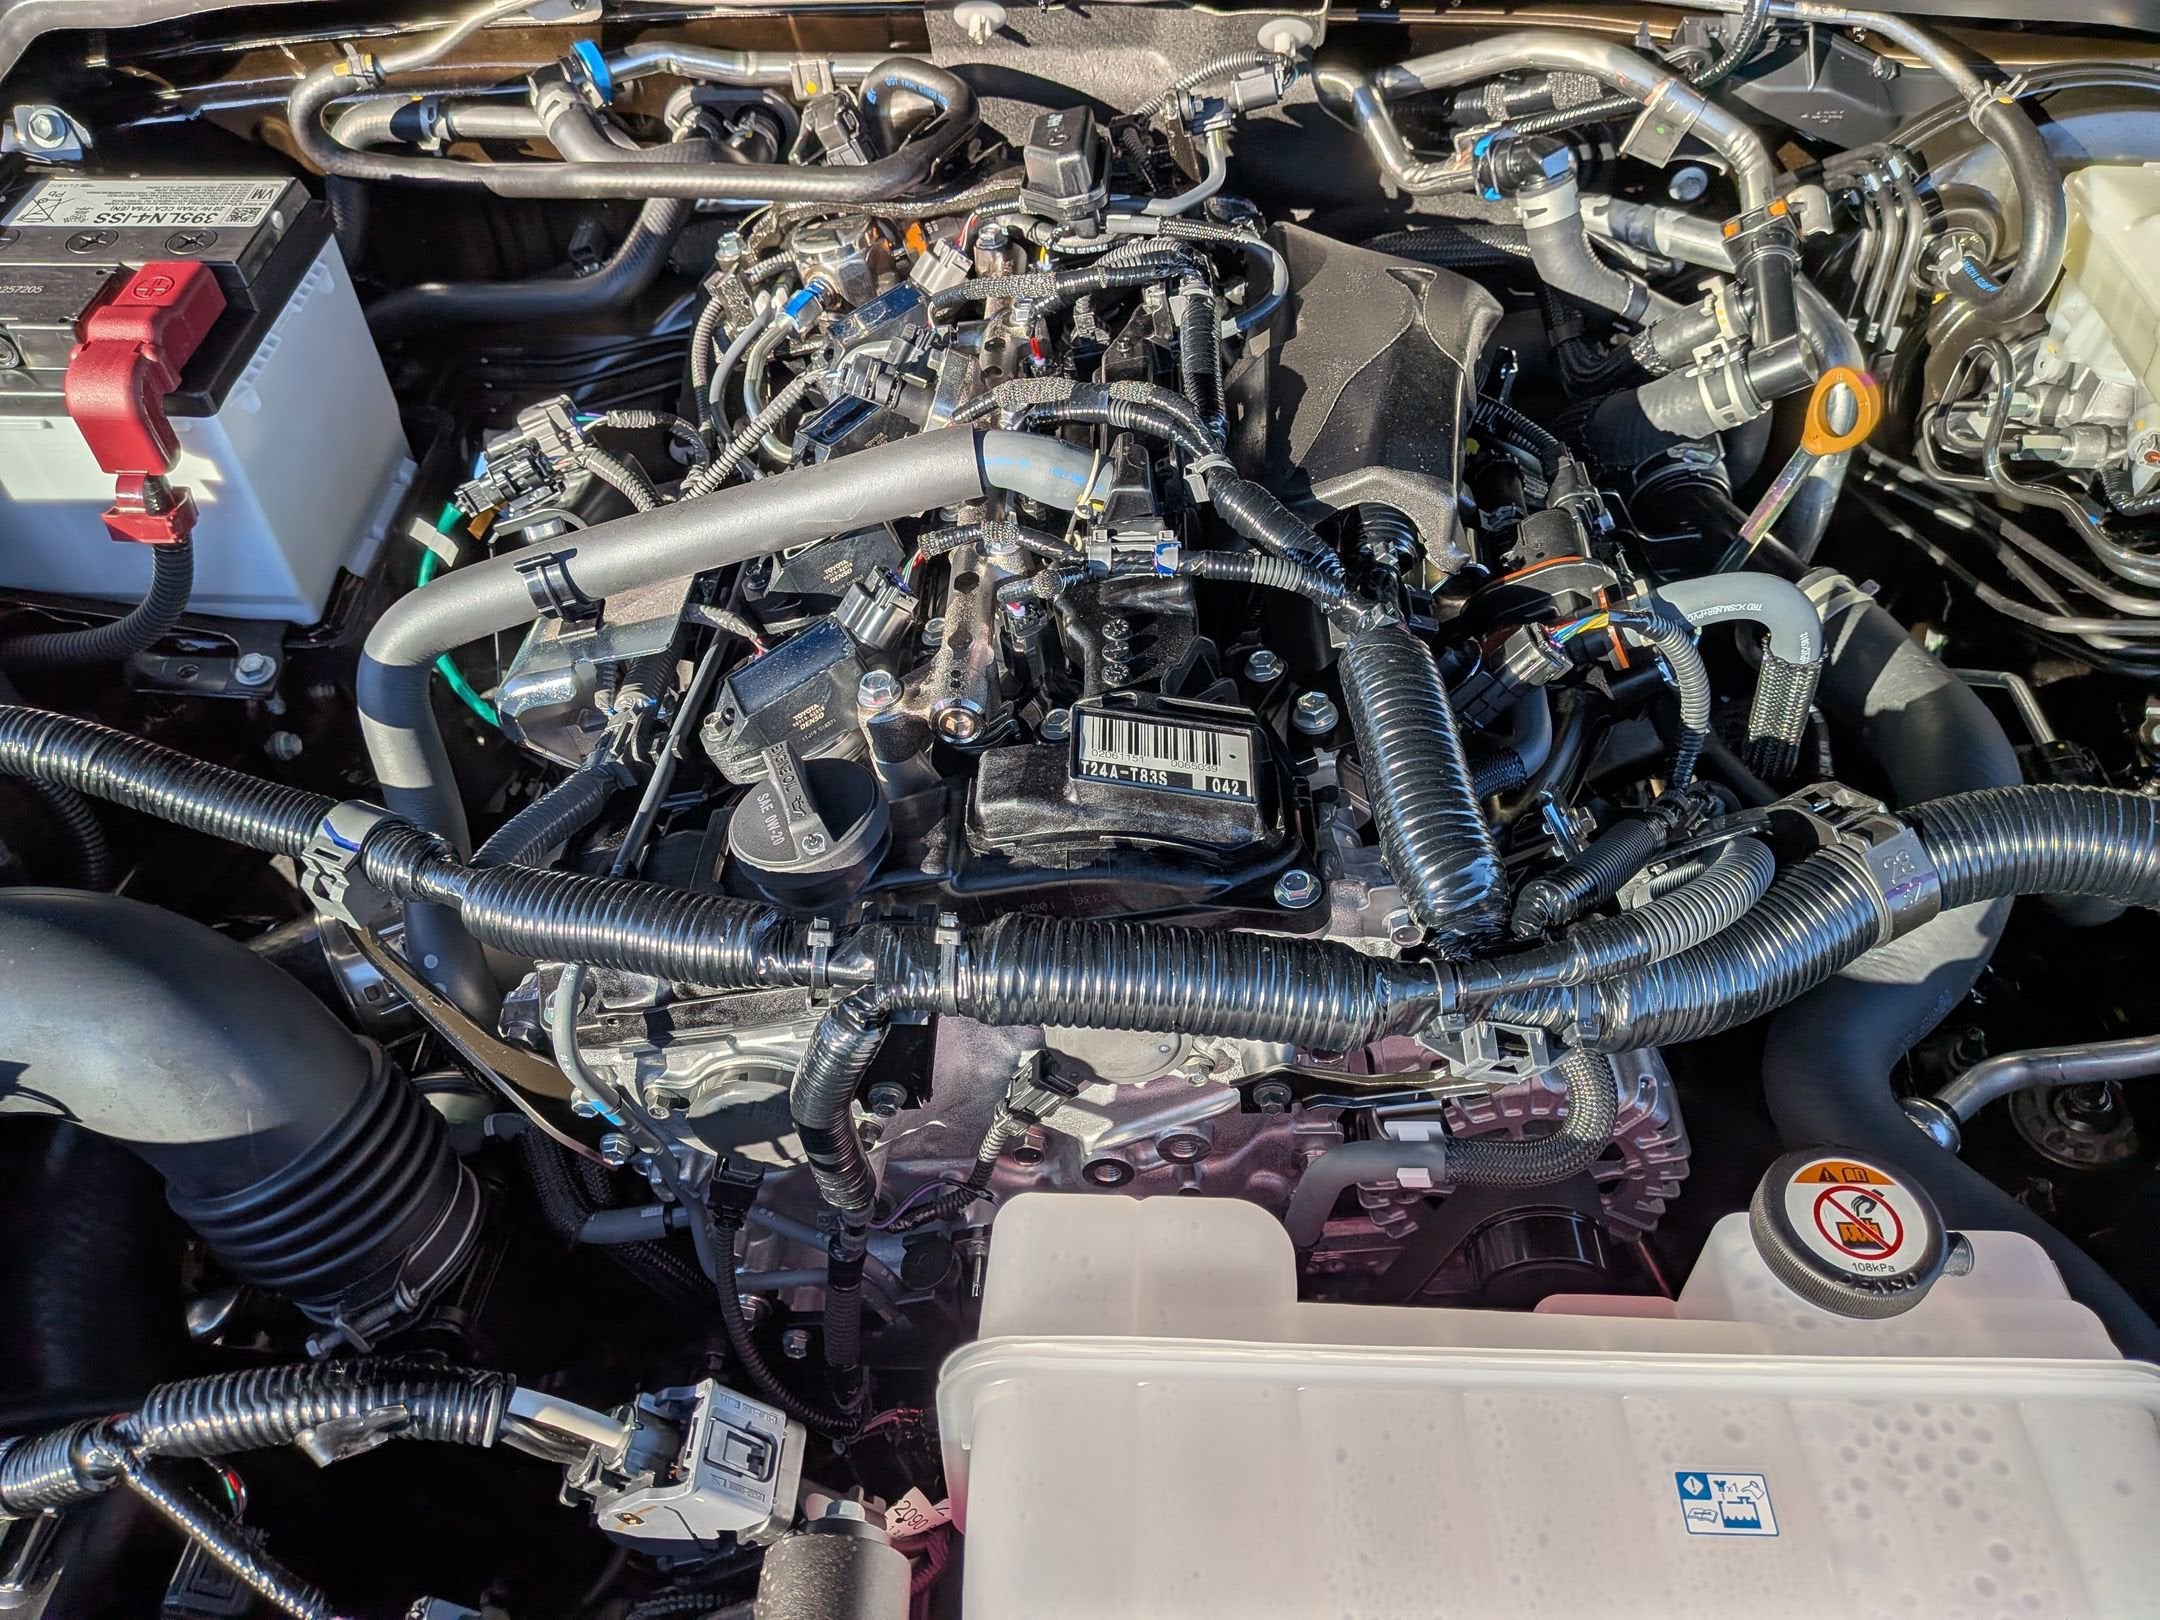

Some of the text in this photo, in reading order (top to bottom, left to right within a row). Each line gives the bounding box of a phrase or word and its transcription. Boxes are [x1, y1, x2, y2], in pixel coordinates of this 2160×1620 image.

[251, 188, 275, 200] VM
[93, 212, 218, 224] 395LN4-ISS
[823, 560, 849, 574] TOYOTA
[830, 568, 852, 583] DENSO
[1747, 603, 1763, 612] TRD
[792, 703, 820, 720] TOYOTA
[800, 712, 825, 730] DENSO
[771, 744, 797, 793] ENGINE OIL
[1091, 749, 1218, 773] 02061151 0065039
[1081, 761, 1240, 796] T24A-T83S 042
[757, 792, 785, 846] SAE 0W-20
[1852, 1262, 1896, 1273] 108kPa
[1726, 1482, 1739, 1493] x1
[894, 1500, 929, 1530] 2090
